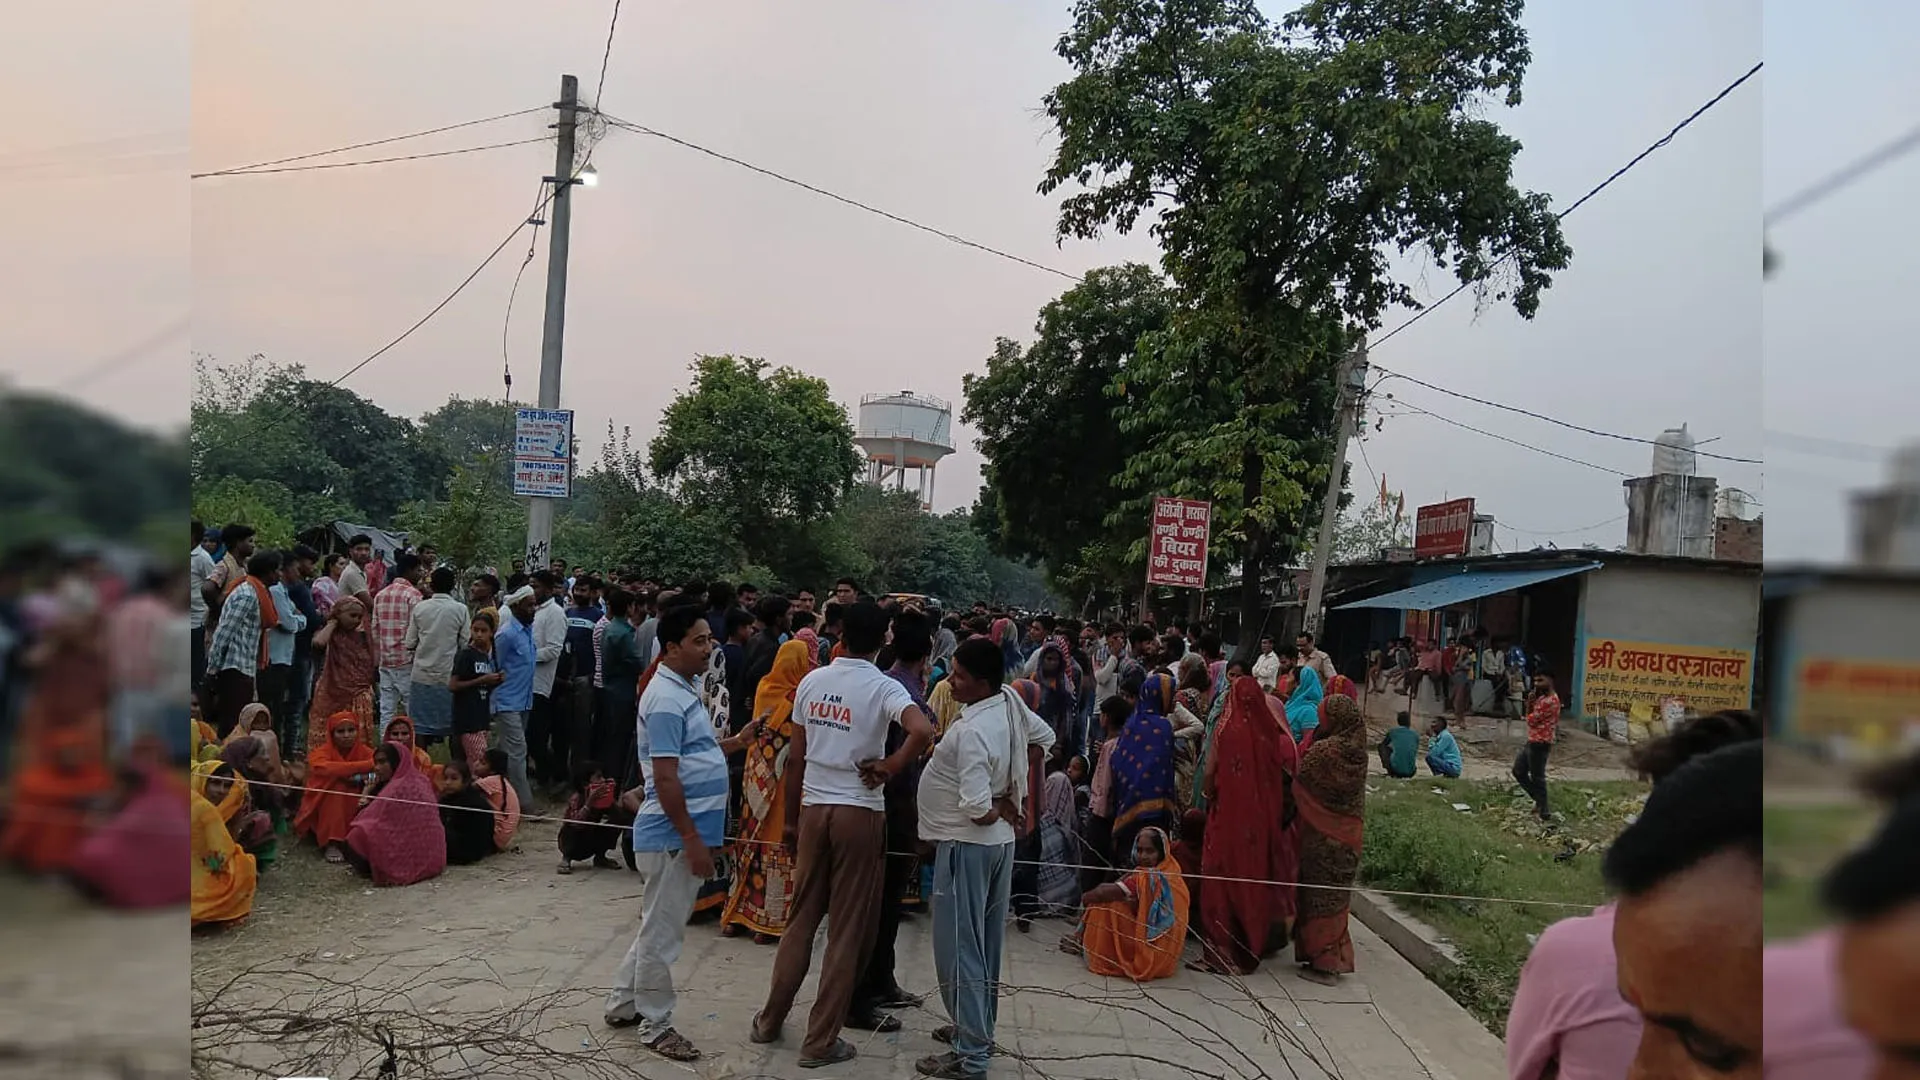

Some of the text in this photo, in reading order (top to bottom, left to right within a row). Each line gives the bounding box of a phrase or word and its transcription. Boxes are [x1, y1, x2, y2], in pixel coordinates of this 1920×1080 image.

[1160, 537, 1198, 556] बियर
[1153, 554, 1203, 573] की दुकान
[1588, 641, 1746, 679] श्री अवध वस्त्रालय
[823, 693, 842, 704] I AM
[809, 701, 851, 724] YUVA
